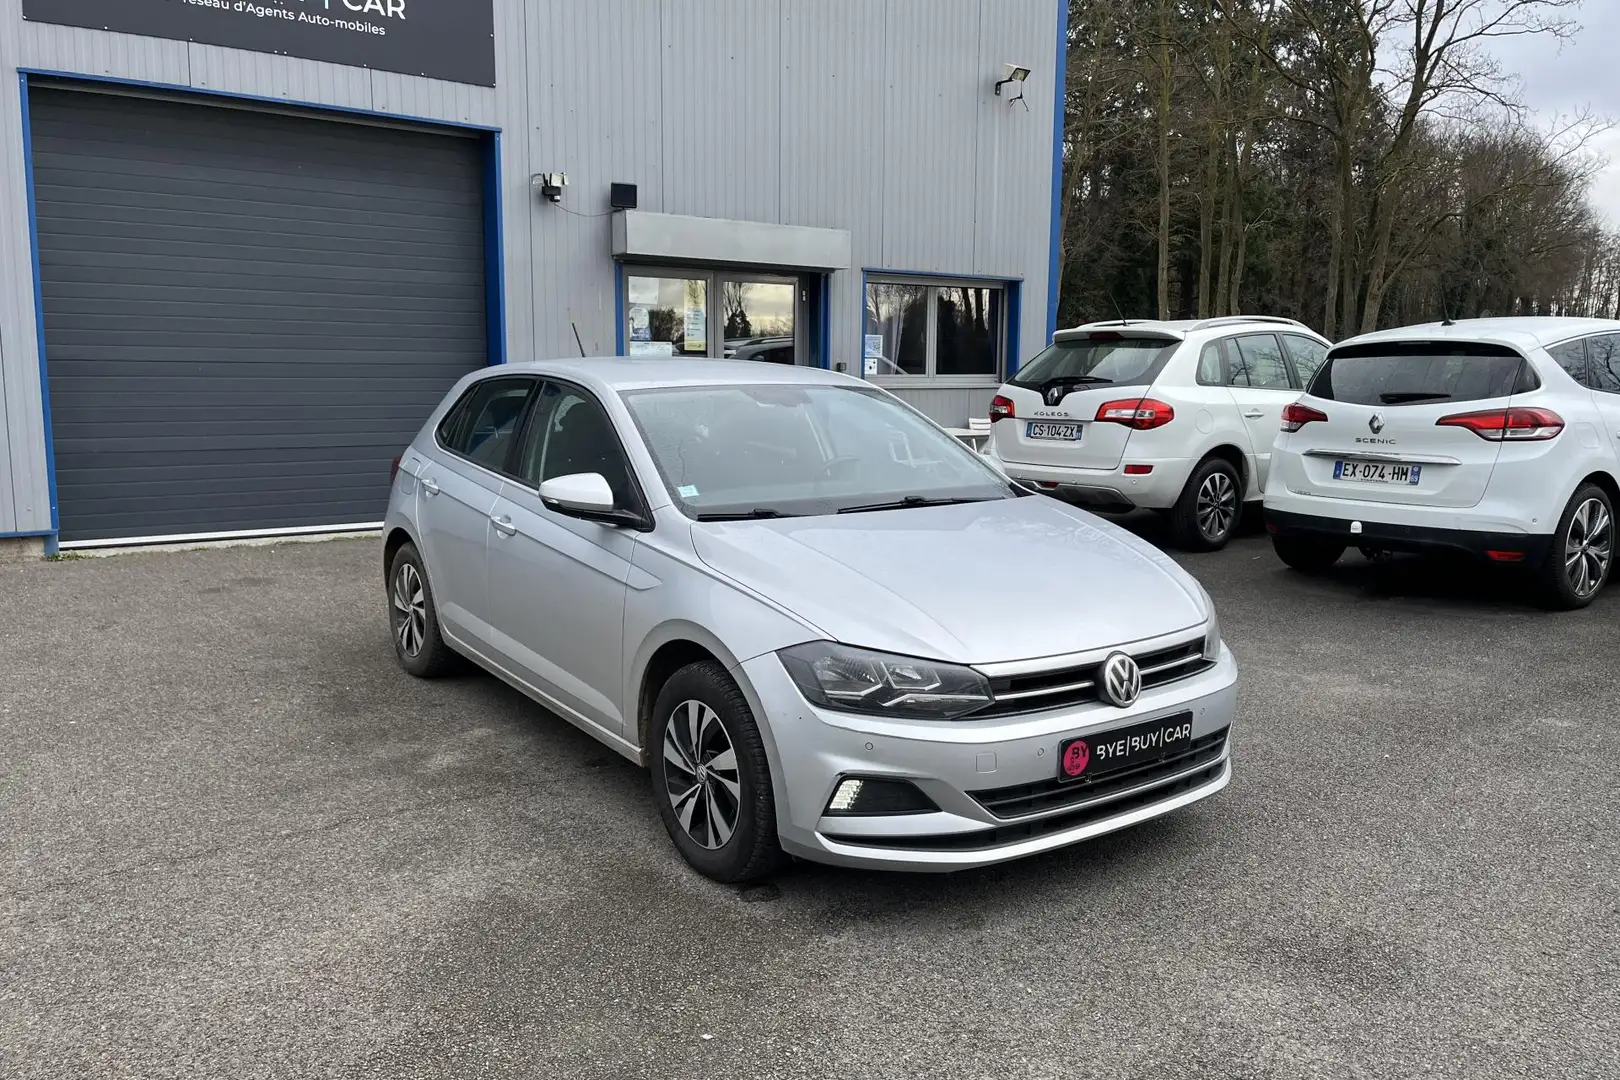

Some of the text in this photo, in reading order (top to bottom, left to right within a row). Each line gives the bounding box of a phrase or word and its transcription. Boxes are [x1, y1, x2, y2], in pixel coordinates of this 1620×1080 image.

[233, 2, 295, 21] d'Agents
[298, 11, 386, 36] Auto-mobiles
[1355, 437, 1397, 445] SCENIC
